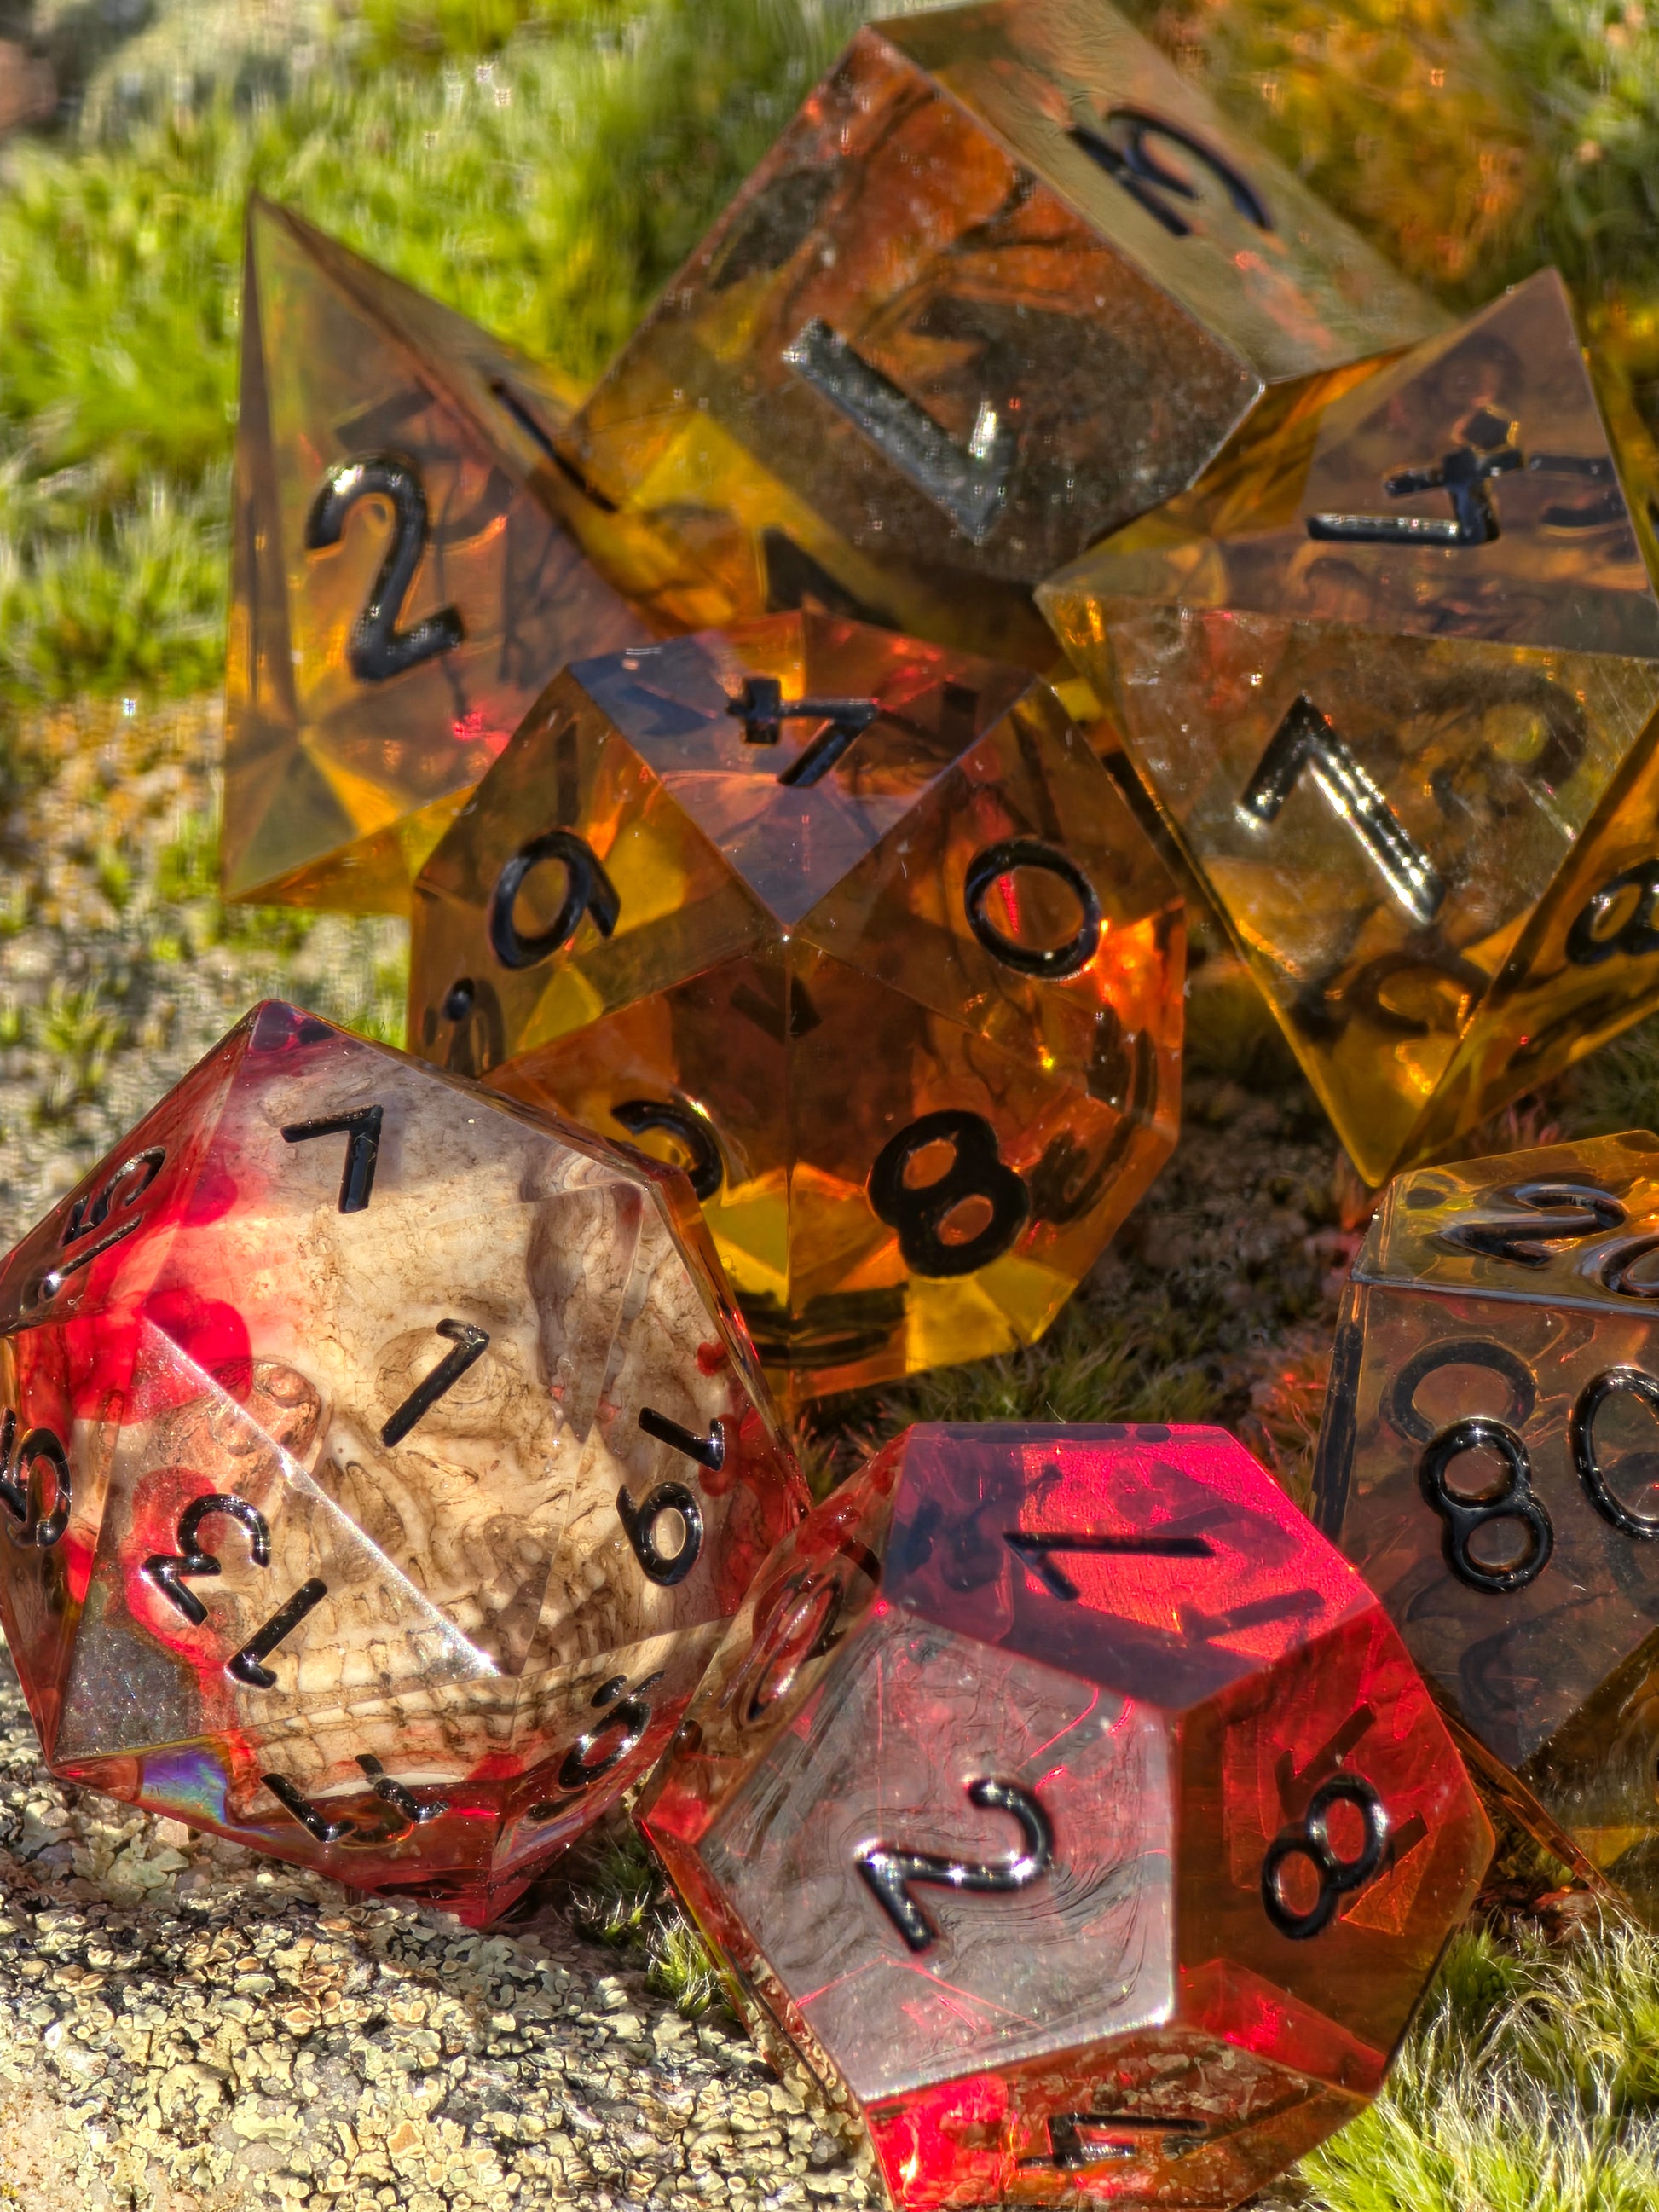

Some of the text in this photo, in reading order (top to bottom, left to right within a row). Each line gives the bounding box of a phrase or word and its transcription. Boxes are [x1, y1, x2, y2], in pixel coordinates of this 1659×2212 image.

[305, 454, 465, 682] 2
[964, 837, 1102, 982] 0
[280, 1104, 383, 1213] 7
[868, 1109, 1030, 1277] 8
[381, 1318, 490, 1447] 1
[854, 1775, 1055, 1954] 2
[1262, 1774, 1391, 1939] 8
